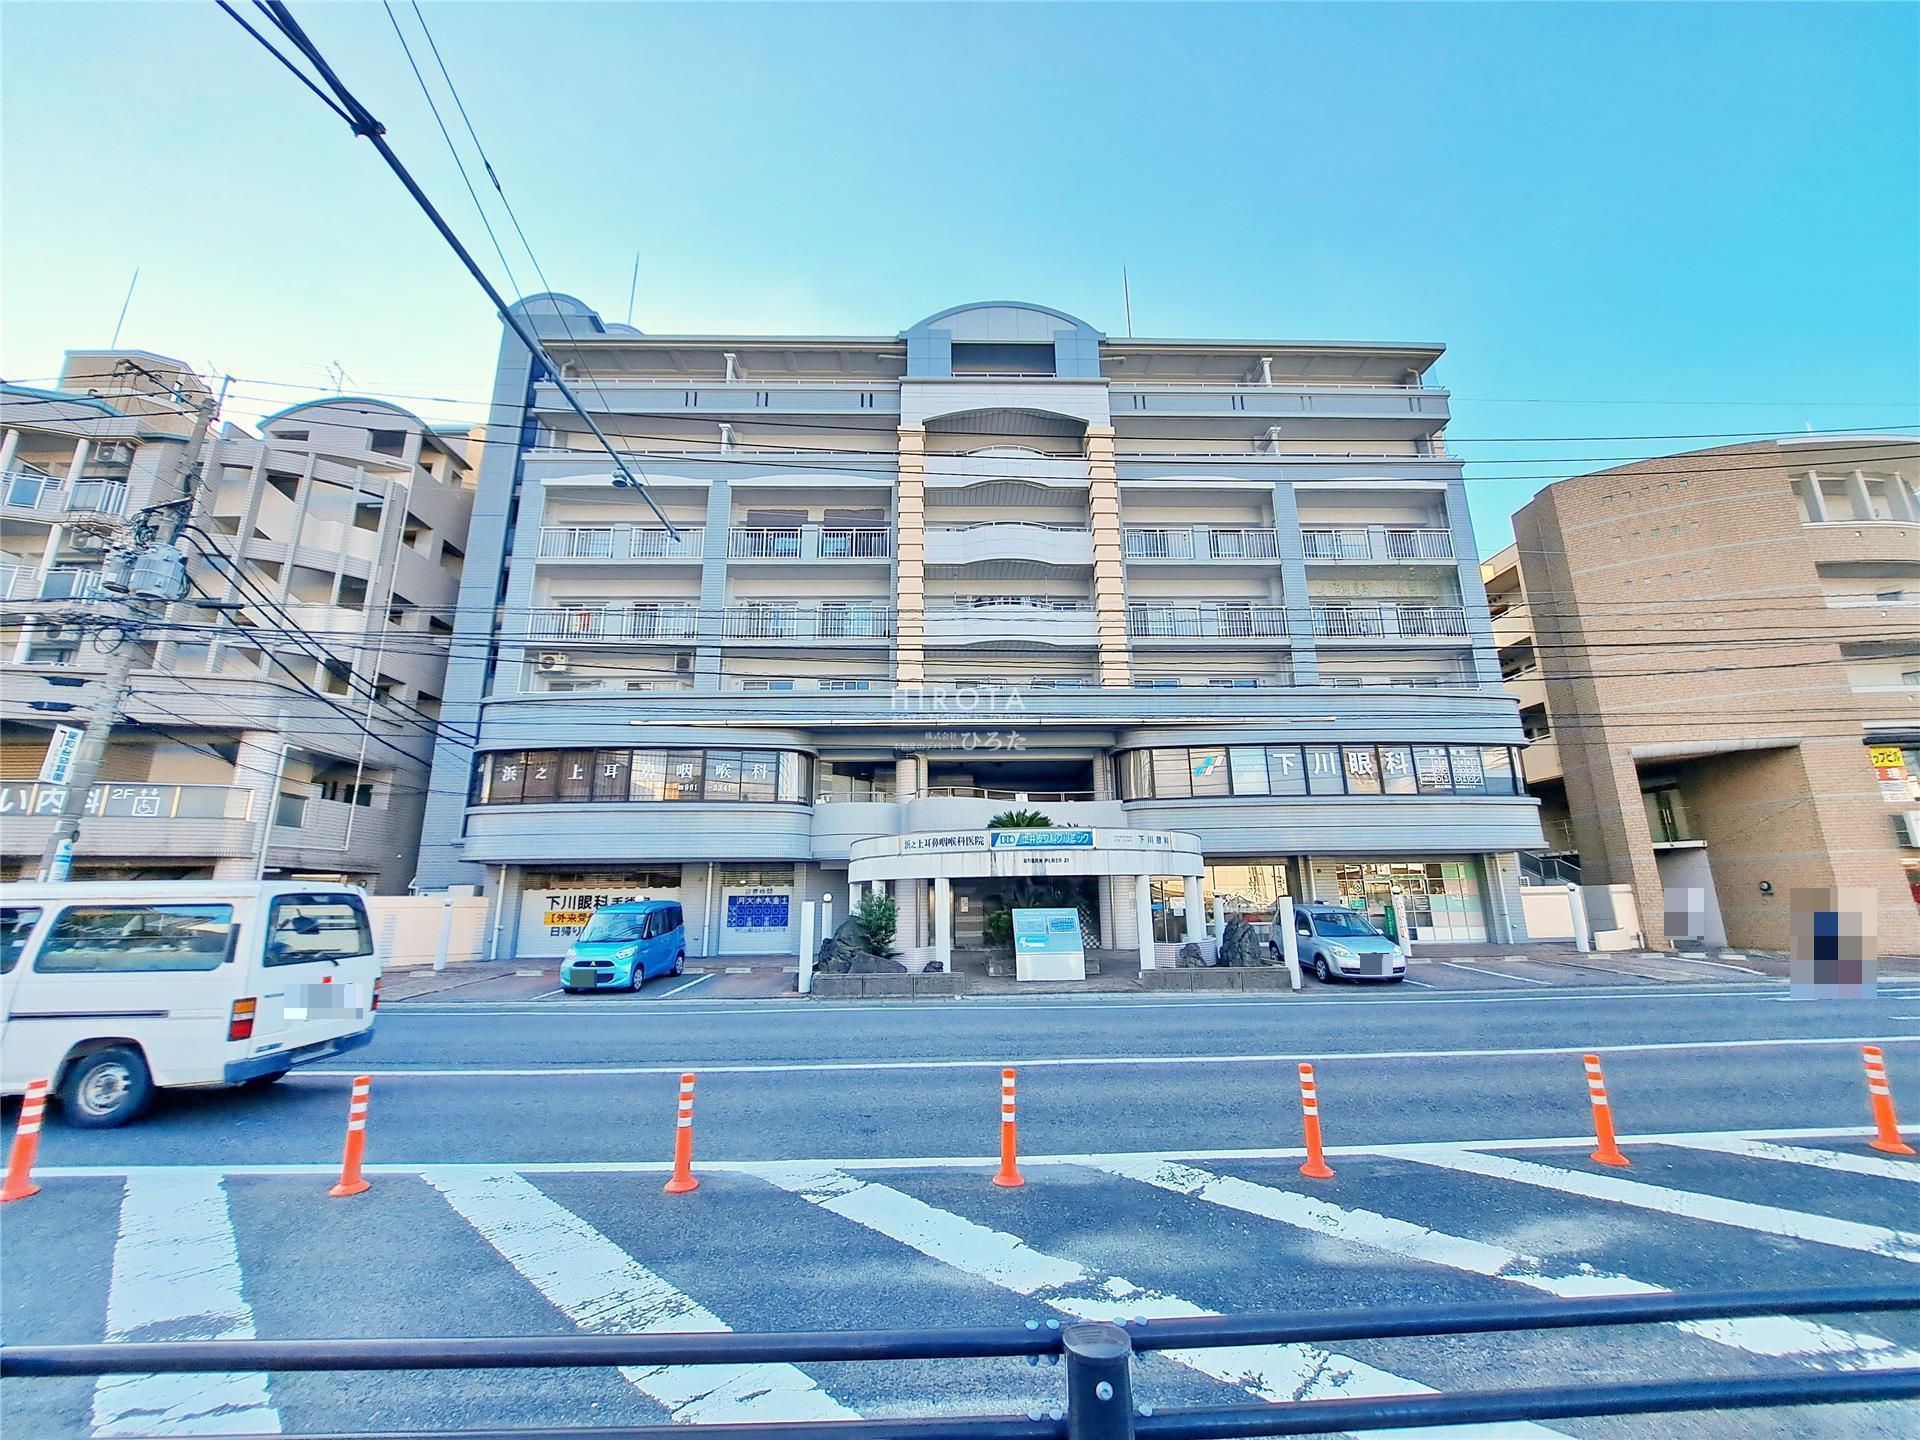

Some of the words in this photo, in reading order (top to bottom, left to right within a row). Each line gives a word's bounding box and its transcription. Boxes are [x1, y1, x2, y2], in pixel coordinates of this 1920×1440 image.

[1272, 751, 1408, 776] 下川眼科
[111, 788, 135, 800] 2F
